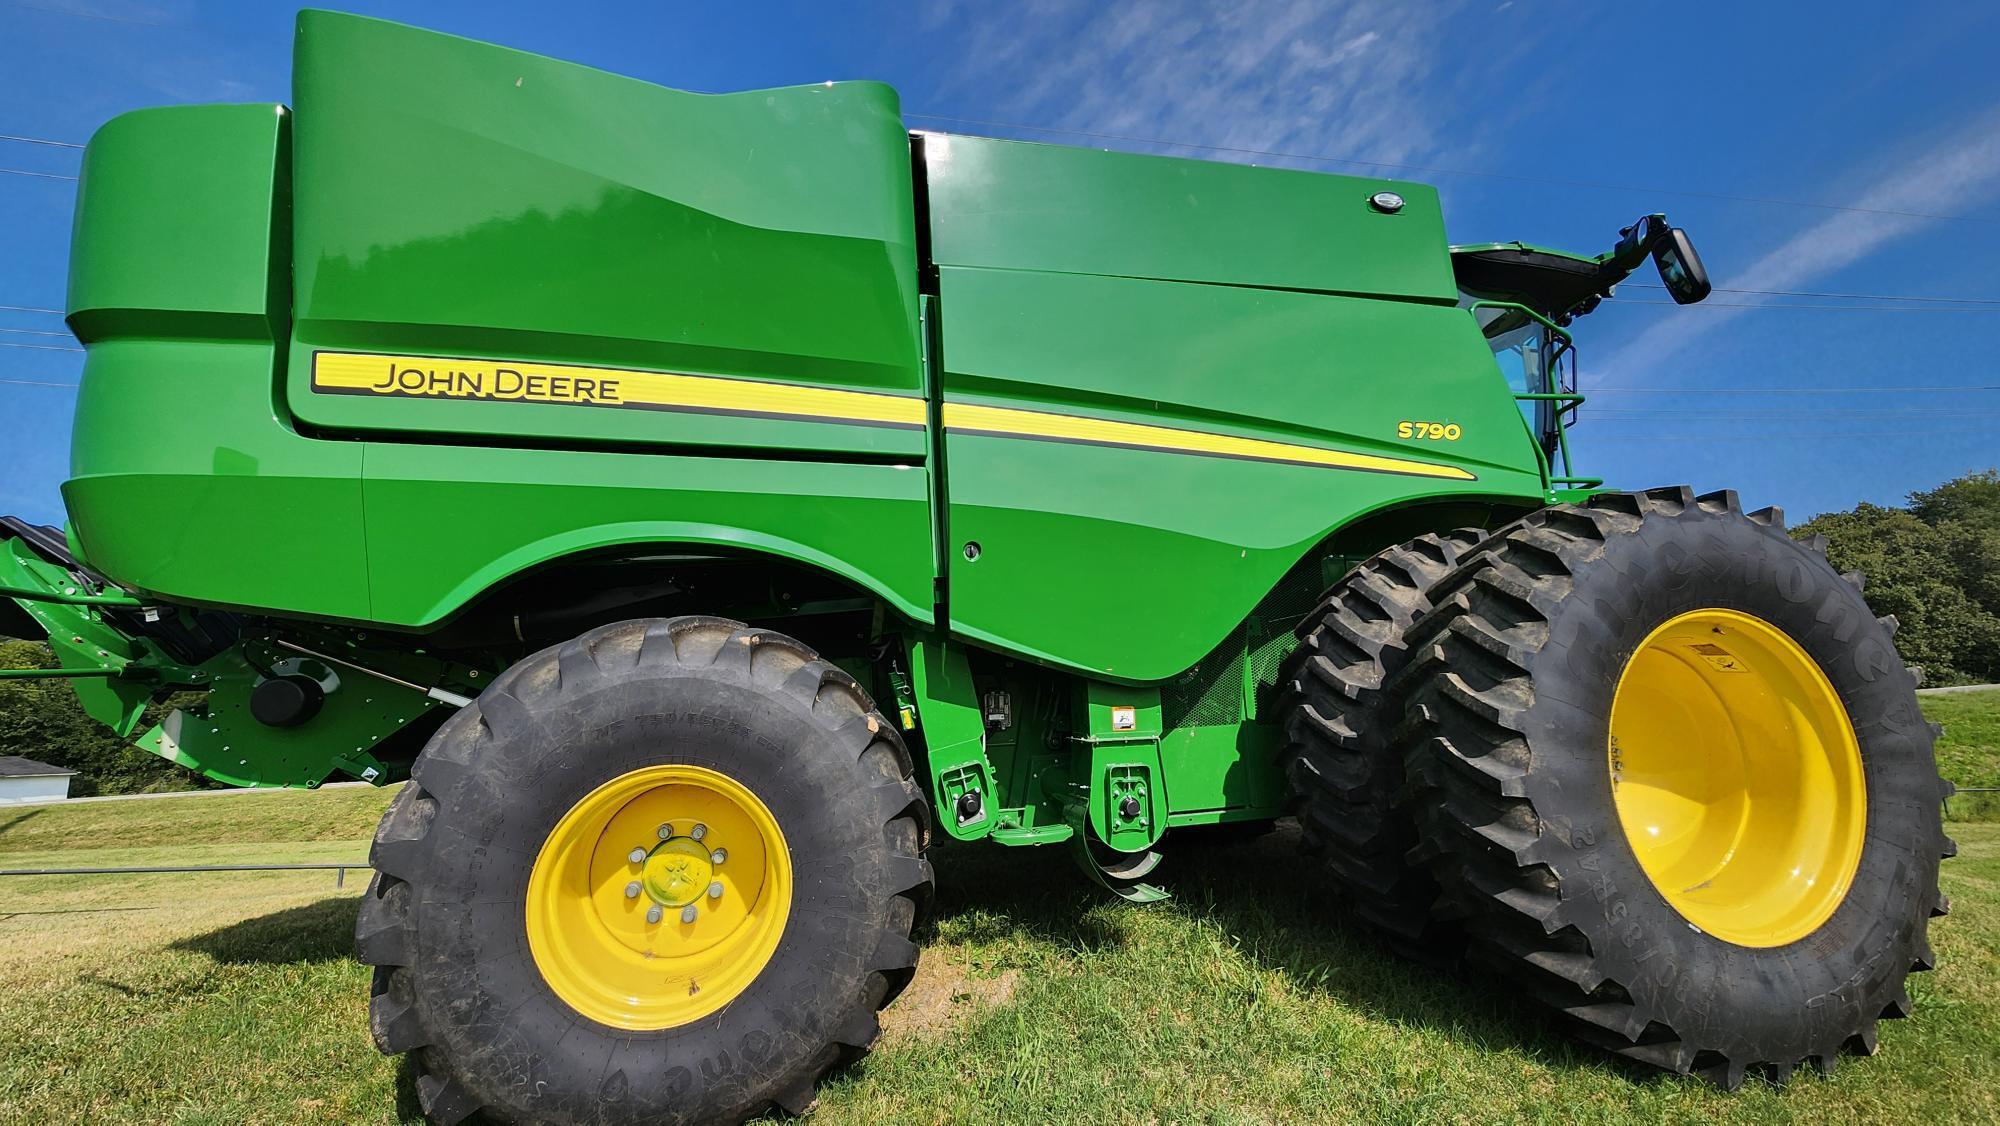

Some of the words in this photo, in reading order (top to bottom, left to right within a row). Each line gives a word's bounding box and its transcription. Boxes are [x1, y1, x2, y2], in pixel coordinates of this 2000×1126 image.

[374, 363, 483, 393] JOHN
[494, 369, 621, 400] DEERE
[1398, 421, 1461, 441] S790
